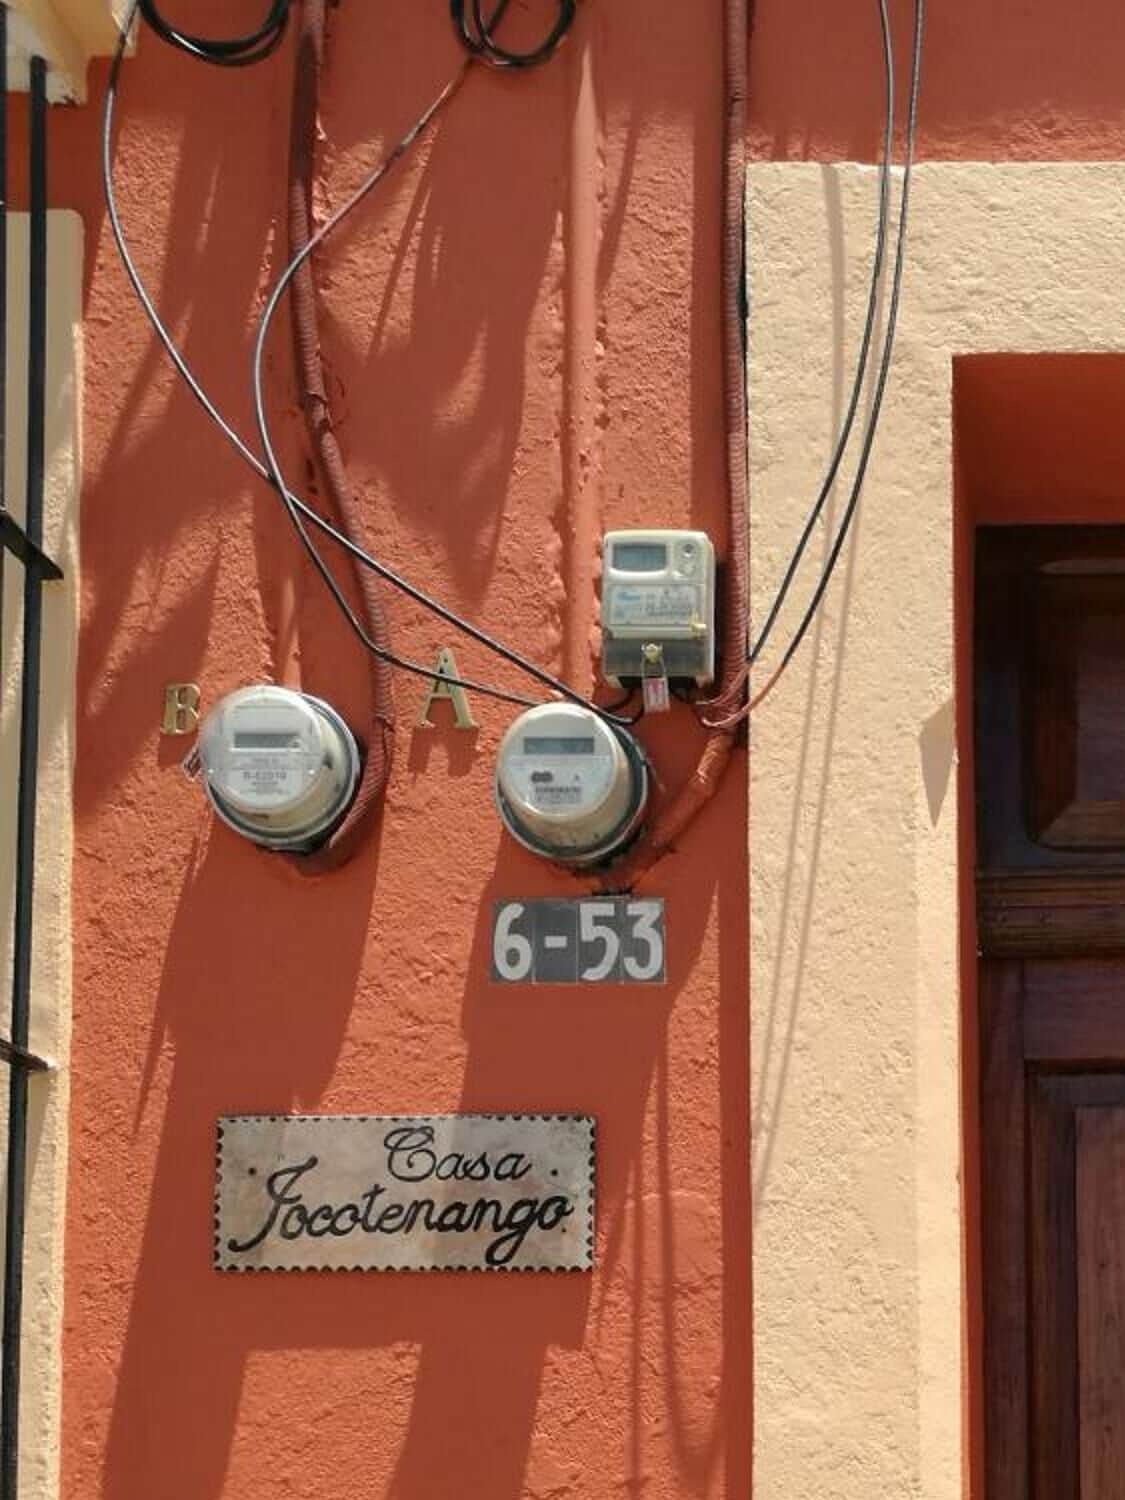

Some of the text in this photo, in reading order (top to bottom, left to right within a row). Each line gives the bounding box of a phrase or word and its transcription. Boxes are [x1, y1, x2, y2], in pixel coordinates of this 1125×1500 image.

[159, 681, 202, 736] B
[416, 646, 476, 729] A
[493, 901, 664, 981] 6-53
[383, 1125, 533, 1182] Casa
[227, 1155, 575, 1266] Jocotenango
